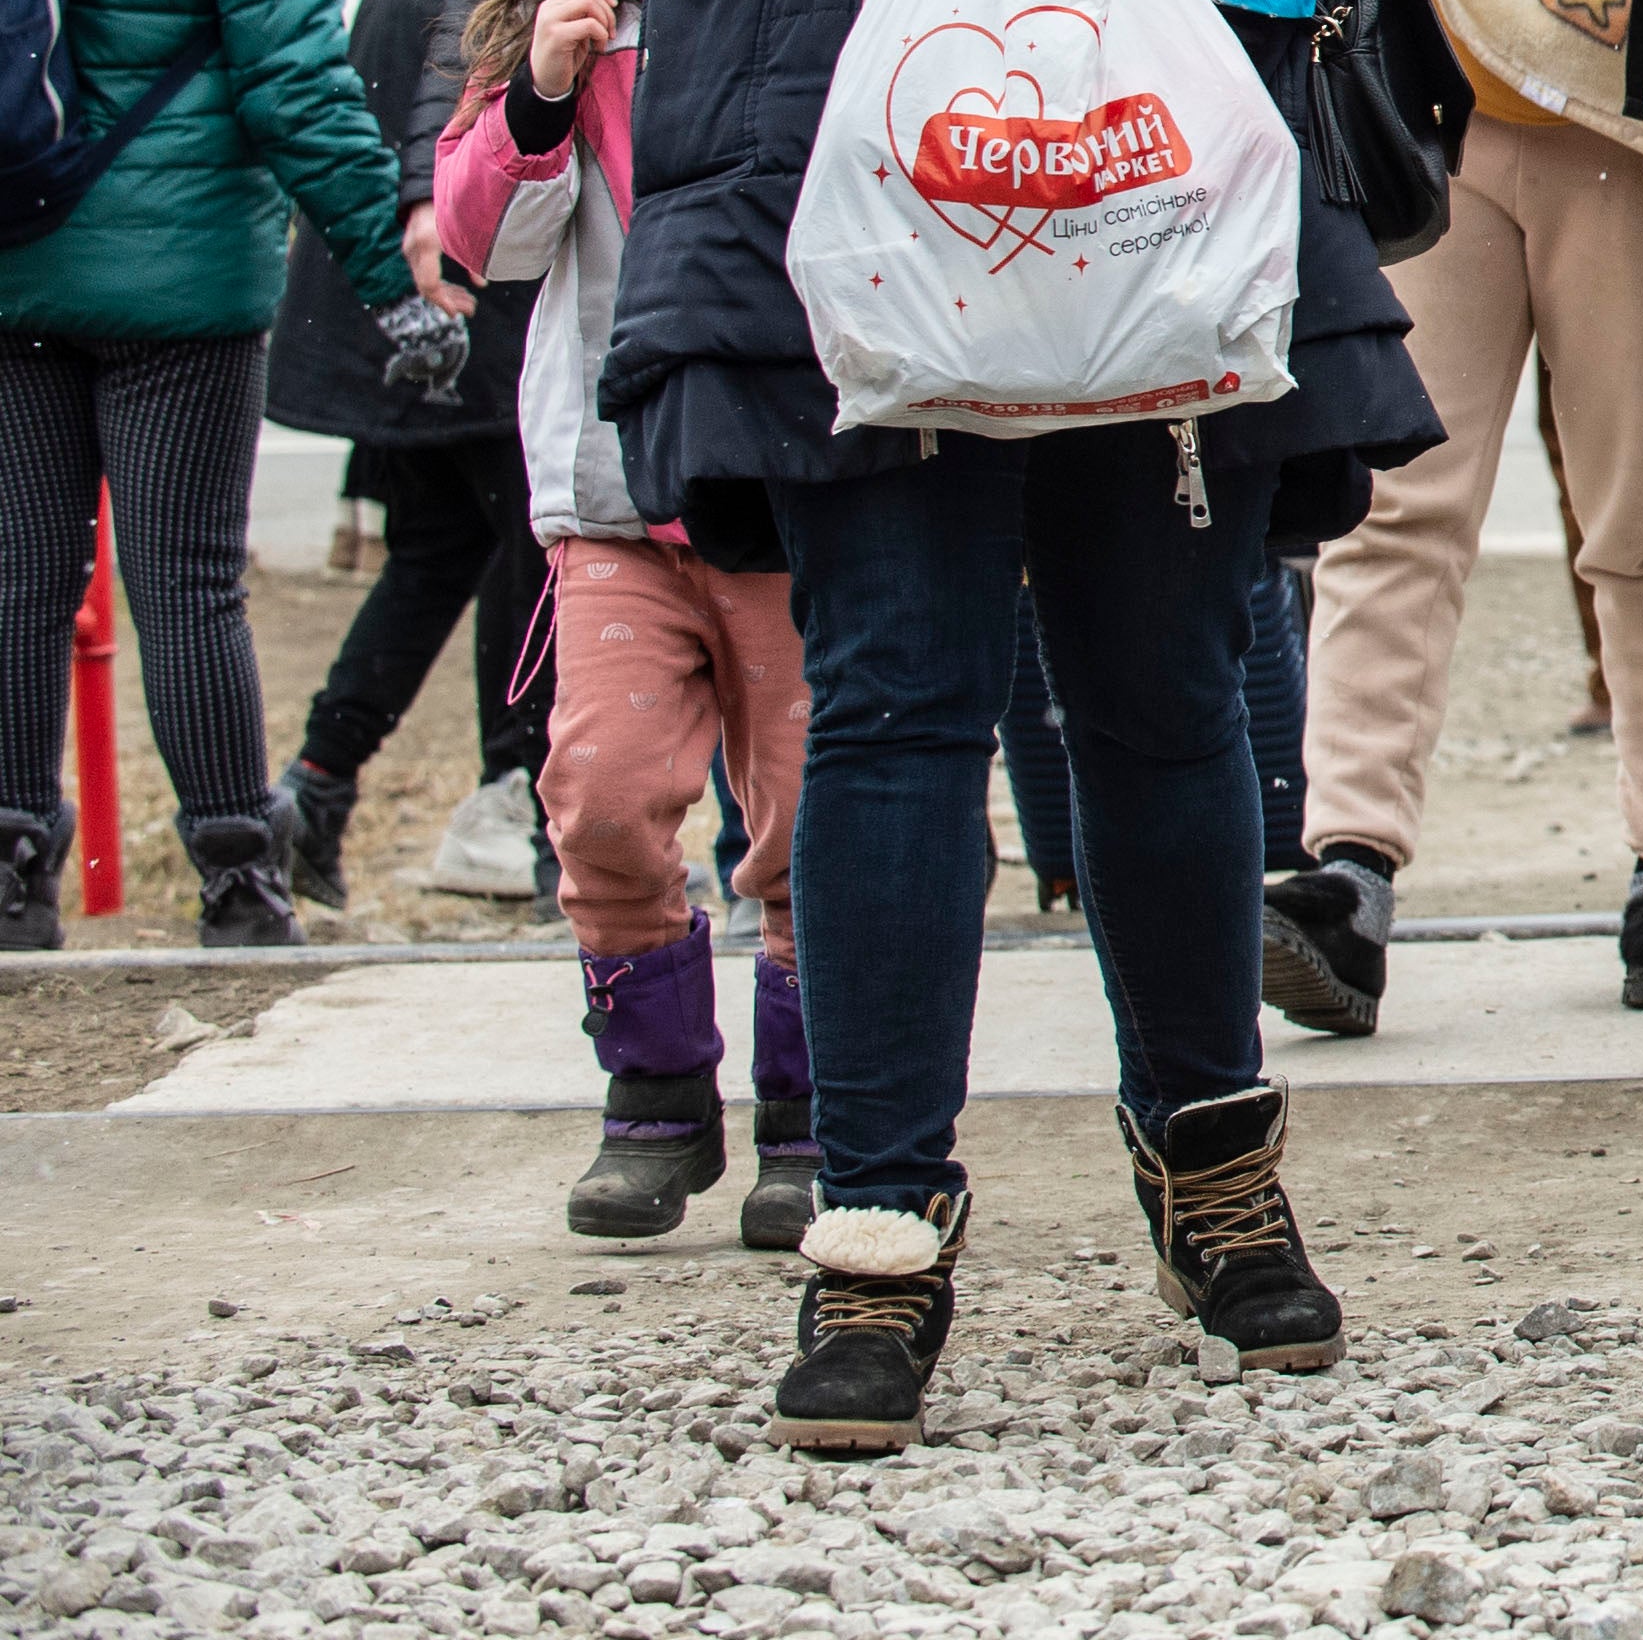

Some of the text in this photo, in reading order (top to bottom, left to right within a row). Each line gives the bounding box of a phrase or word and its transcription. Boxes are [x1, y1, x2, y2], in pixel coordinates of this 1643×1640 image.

[948, 104, 1169, 189] Червоний
[1094, 149, 1176, 192] МАРКЕТ
[1052, 186, 1207, 240] Ціни самісіньке
[1109, 212, 1210, 257] сердечко!
